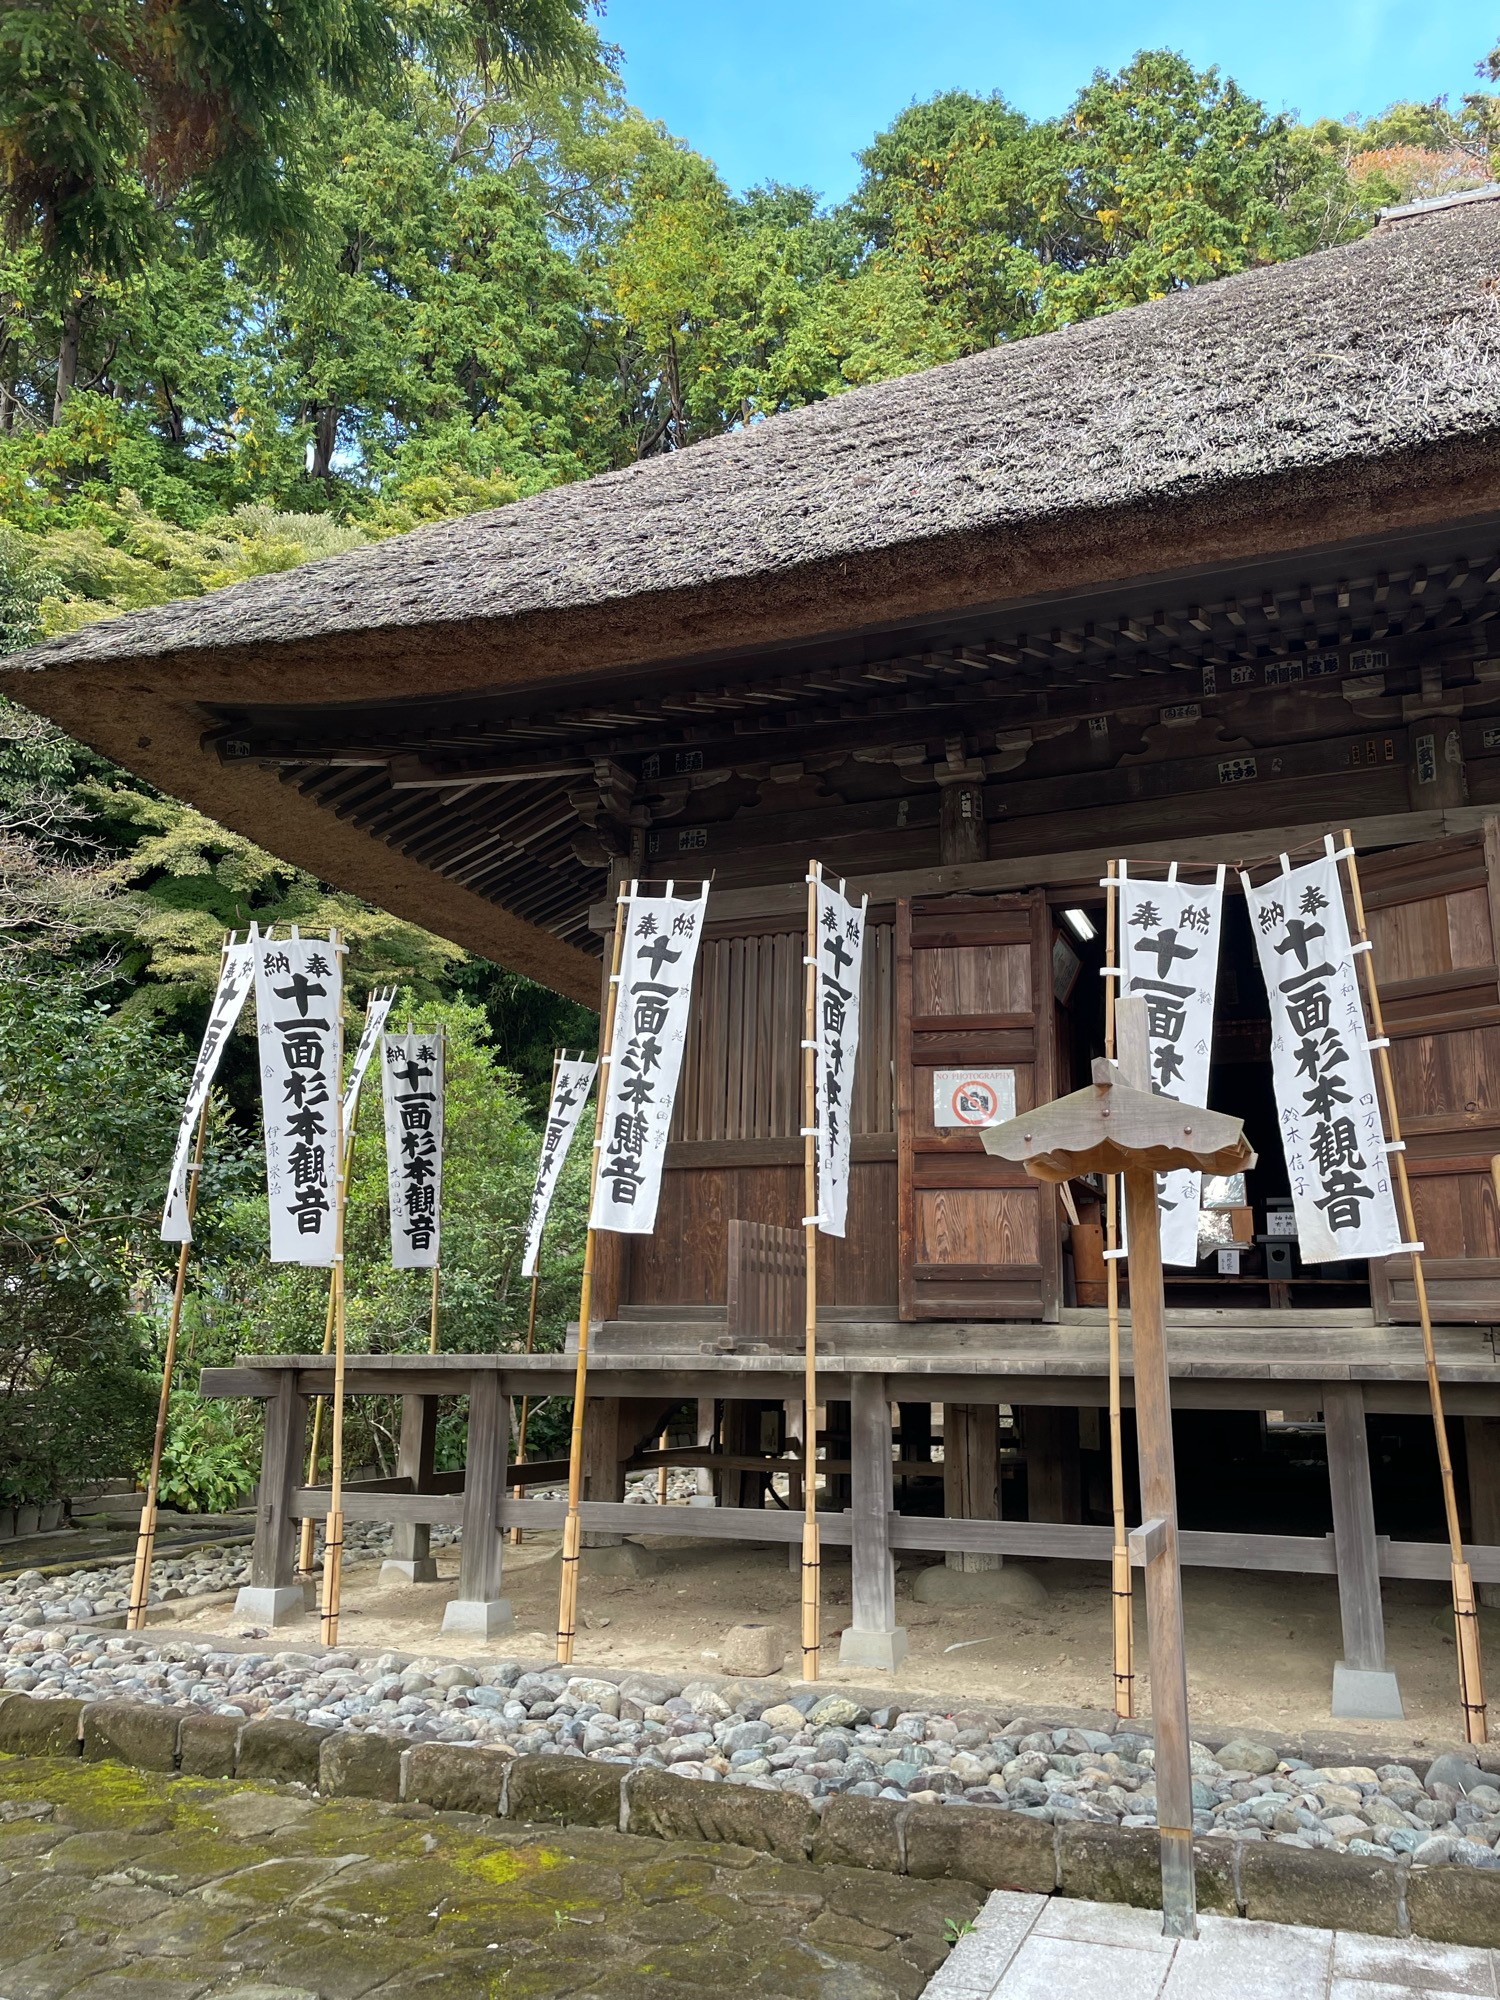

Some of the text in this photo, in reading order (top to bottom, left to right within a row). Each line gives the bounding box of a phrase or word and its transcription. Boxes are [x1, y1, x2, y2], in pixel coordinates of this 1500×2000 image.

[272, 973, 330, 1235] 十一面杉本観音
[392, 1060, 437, 1251] 十一面杉本観音
[936, 1072, 1011, 1080] NO PHOTOGRAPHY
[1269, 984, 1285, 1053] 川崎
[1280, 1107, 1310, 1197] 鈴木信子
[1273, 919, 1375, 1233] 十一面杉本観音
[1337, 960, 1388, 1194] 令和五年 四万六千日
